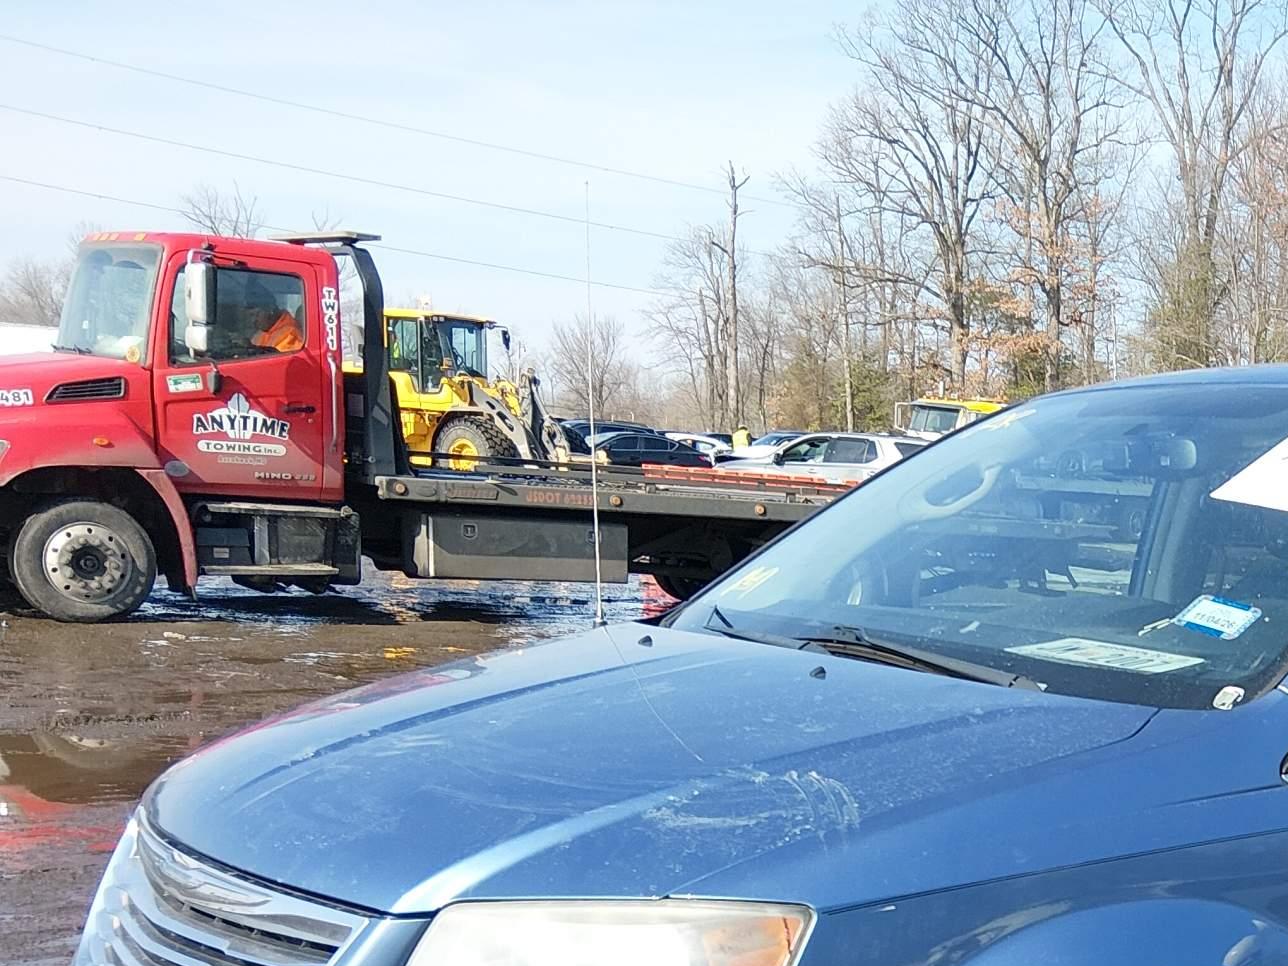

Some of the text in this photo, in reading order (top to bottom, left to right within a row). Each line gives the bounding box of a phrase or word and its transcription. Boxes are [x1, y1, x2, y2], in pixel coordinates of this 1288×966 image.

[325, 290, 335, 349] TW611
[194, 413, 289, 438] ANYTIME
[205, 442, 262, 453] TOWING
[254, 471, 292, 480] HINO
